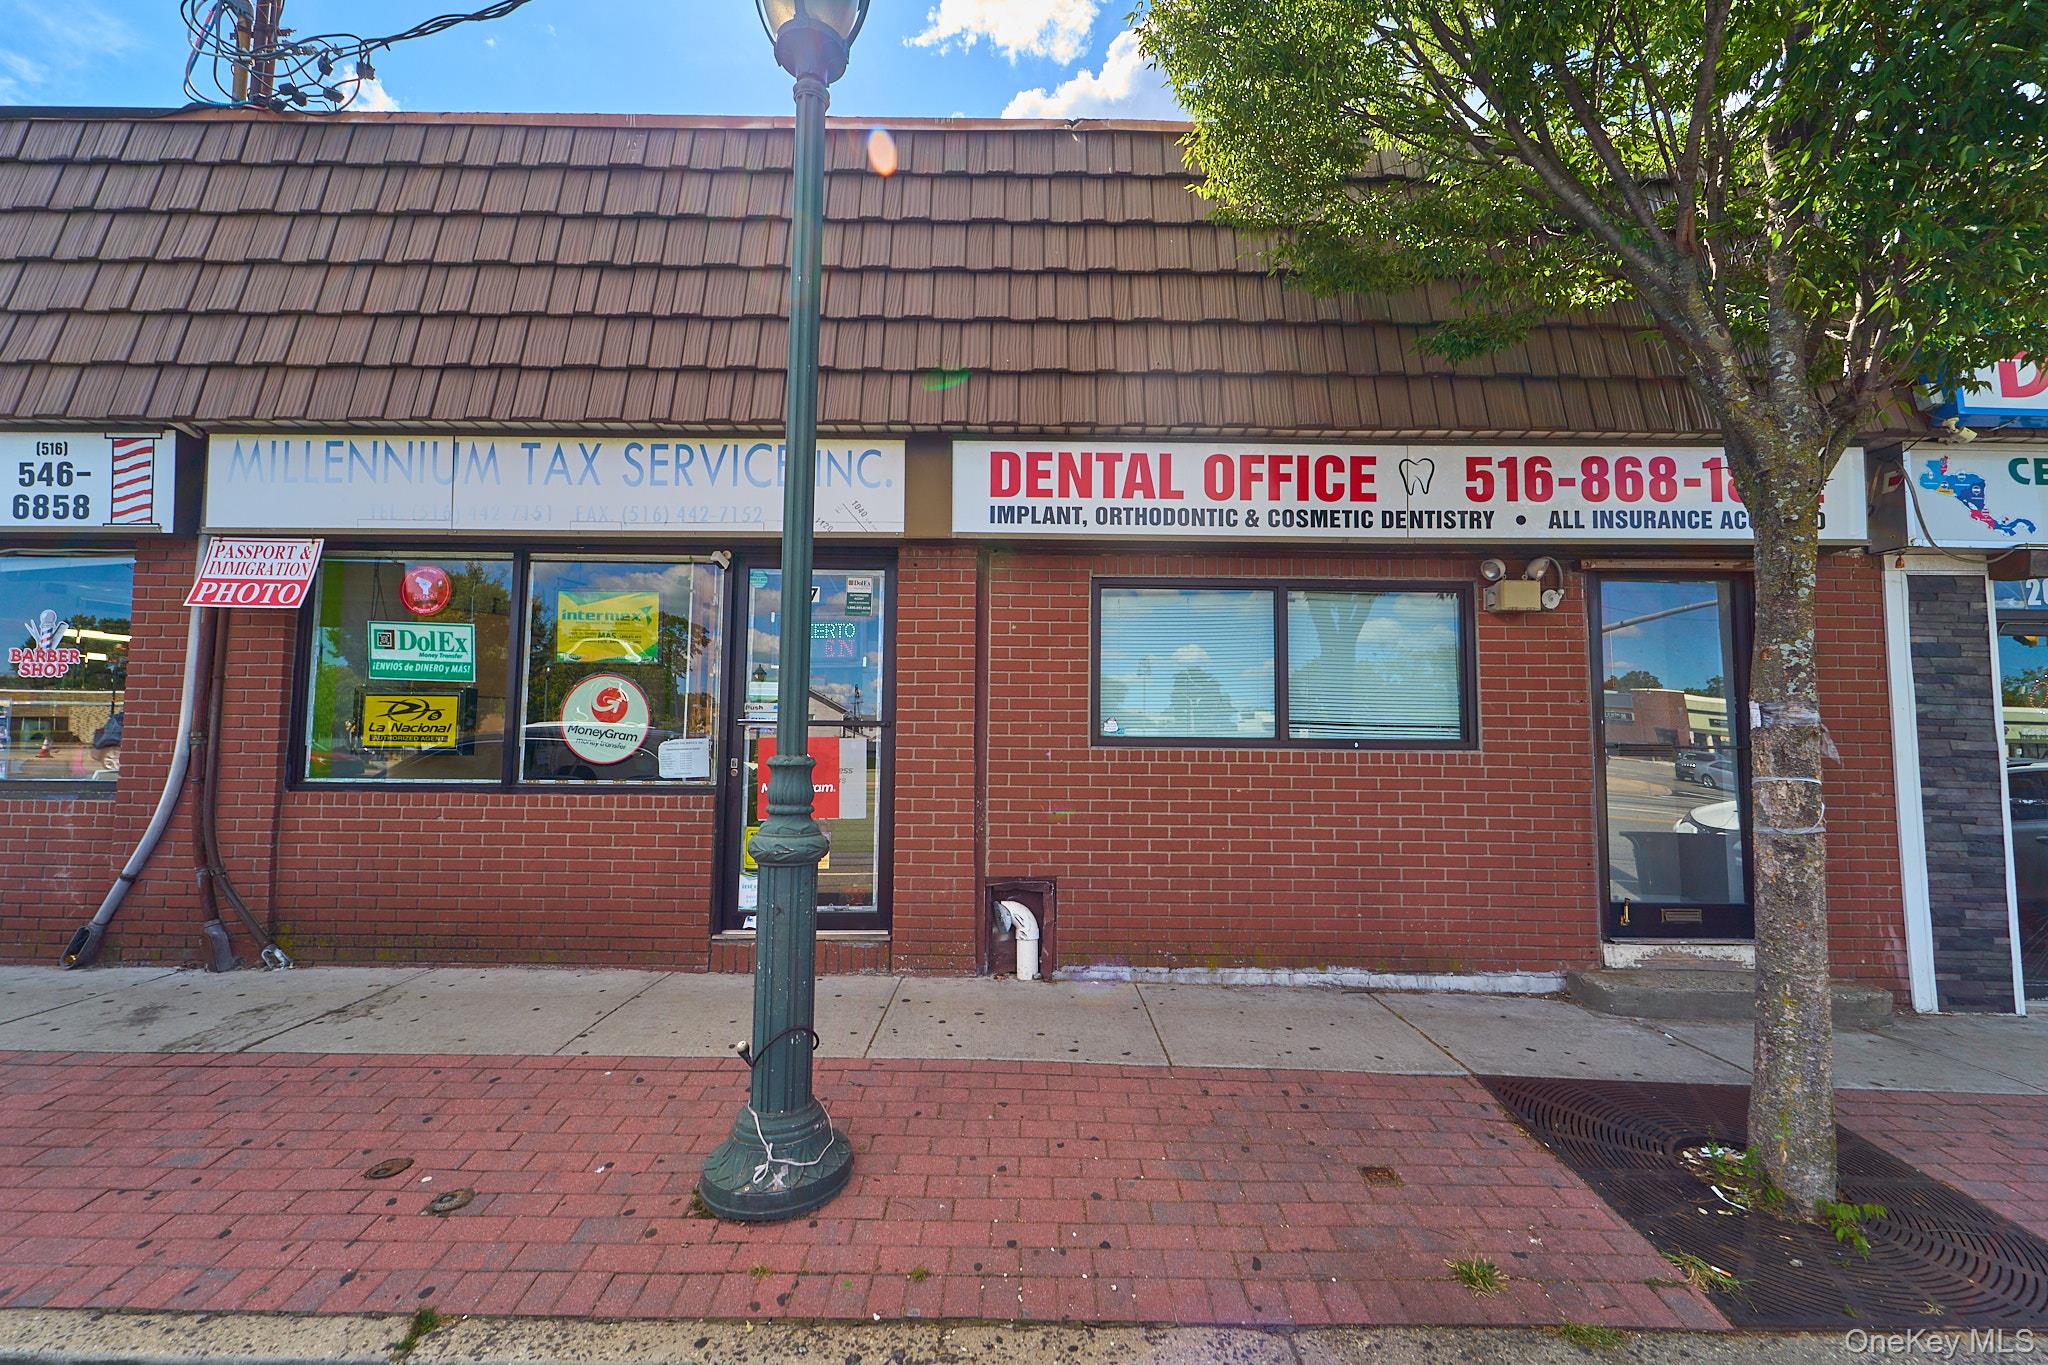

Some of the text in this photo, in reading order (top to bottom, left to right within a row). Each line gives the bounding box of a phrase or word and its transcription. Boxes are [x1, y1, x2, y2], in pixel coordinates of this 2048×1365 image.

[37, 441, 68, 456] (516)
[227, 440, 501, 486] MILLENNIUM
[521, 442, 602, 487] TAX
[815, 448, 893, 489] INC.
[19, 461, 91, 487] 546-
[990, 451, 1377, 503] DENTAL OFFICE
[12, 494, 90, 520] 6858
[622, 503, 669, 525] (516)
[676, 505, 763, 523] 442-7152
[852, 500, 868, 517] 1040
[989, 505, 1495, 529] IMPLANT, ORTHODONTIC & COSMETIC DENTISTRY
[1548, 510, 1585, 530] ALL
[1592, 510, 1712, 530] INSURANCE
[214, 544, 312, 560] PASSPORT &
[208, 561, 310, 577] IMMIGRATION
[193, 581, 301, 604] PHOTO
[561, 608, 642, 622] intermex
[397, 629, 468, 655] DolEx
[10, 648, 81, 664] BARBER
[19, 662, 69, 677] SHOP
[404, 662, 415, 671] de
[415, 663, 444, 673] DINERO
[444, 666, 449, 675] y
[368, 722, 452, 733] La Nacional
[567, 725, 638, 742] MoneyGram
[575, 738, 599, 748] money
